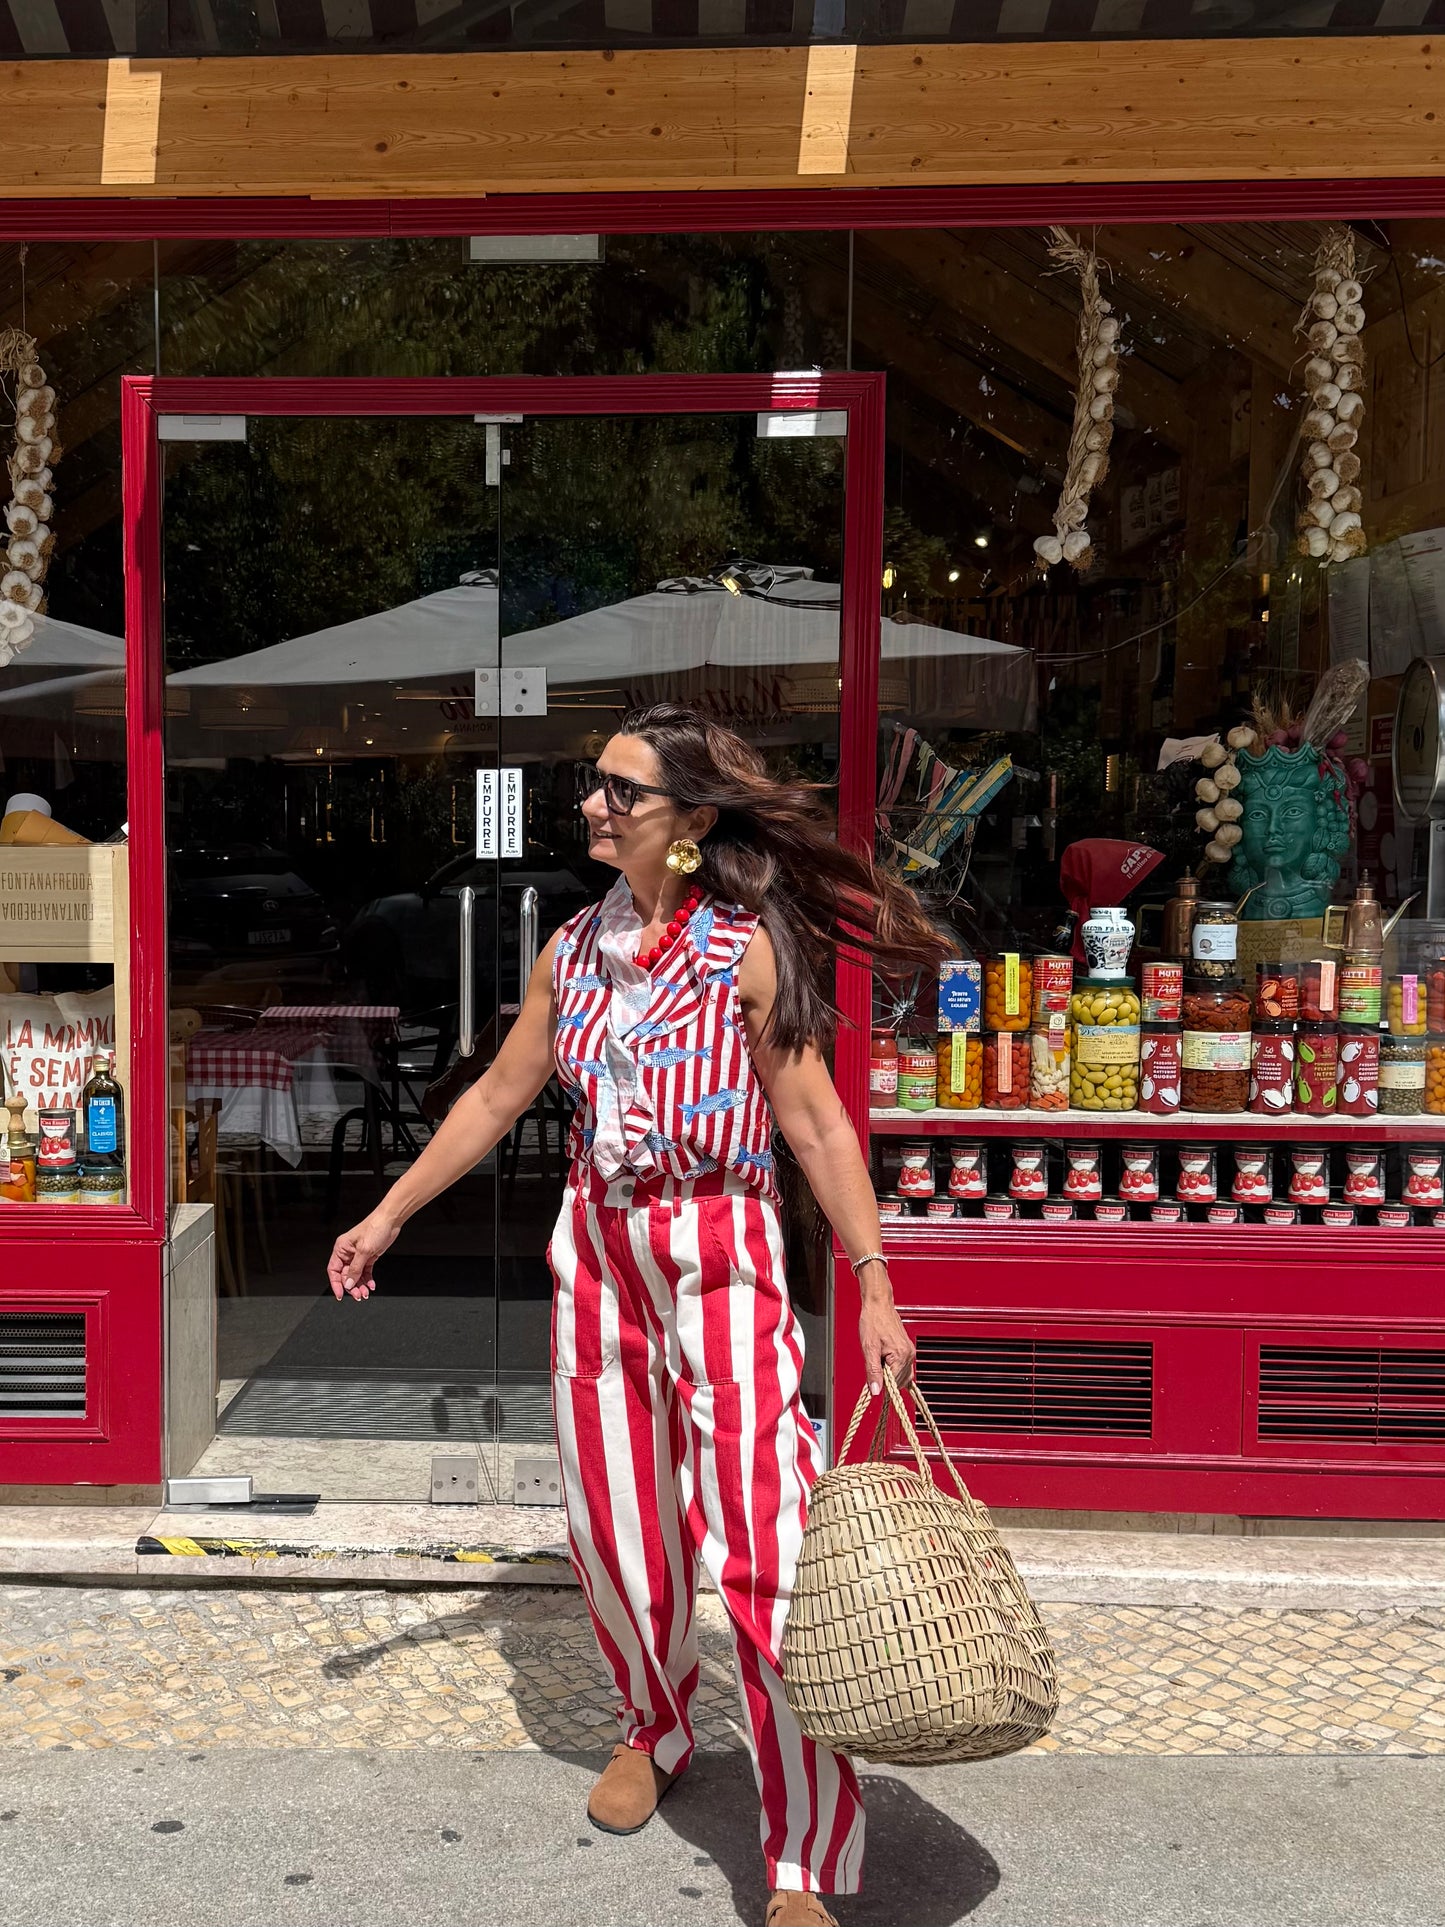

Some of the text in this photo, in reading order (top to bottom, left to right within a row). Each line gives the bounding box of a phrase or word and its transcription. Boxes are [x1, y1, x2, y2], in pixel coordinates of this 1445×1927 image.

[483, 773, 491, 848] EMPURRE
[507, 772, 516, 848] EMPURRE
[1, 872, 94, 891] FONTANAFREDDA
[1, 902, 94, 921] FONTANAFREDDA
[1048, 962, 1071, 970] MUTTI
[7, 1019, 33, 1049] LA
[29, 1052, 117, 1088] SEMPE
[911, 1058, 937, 1067] MUTTI
